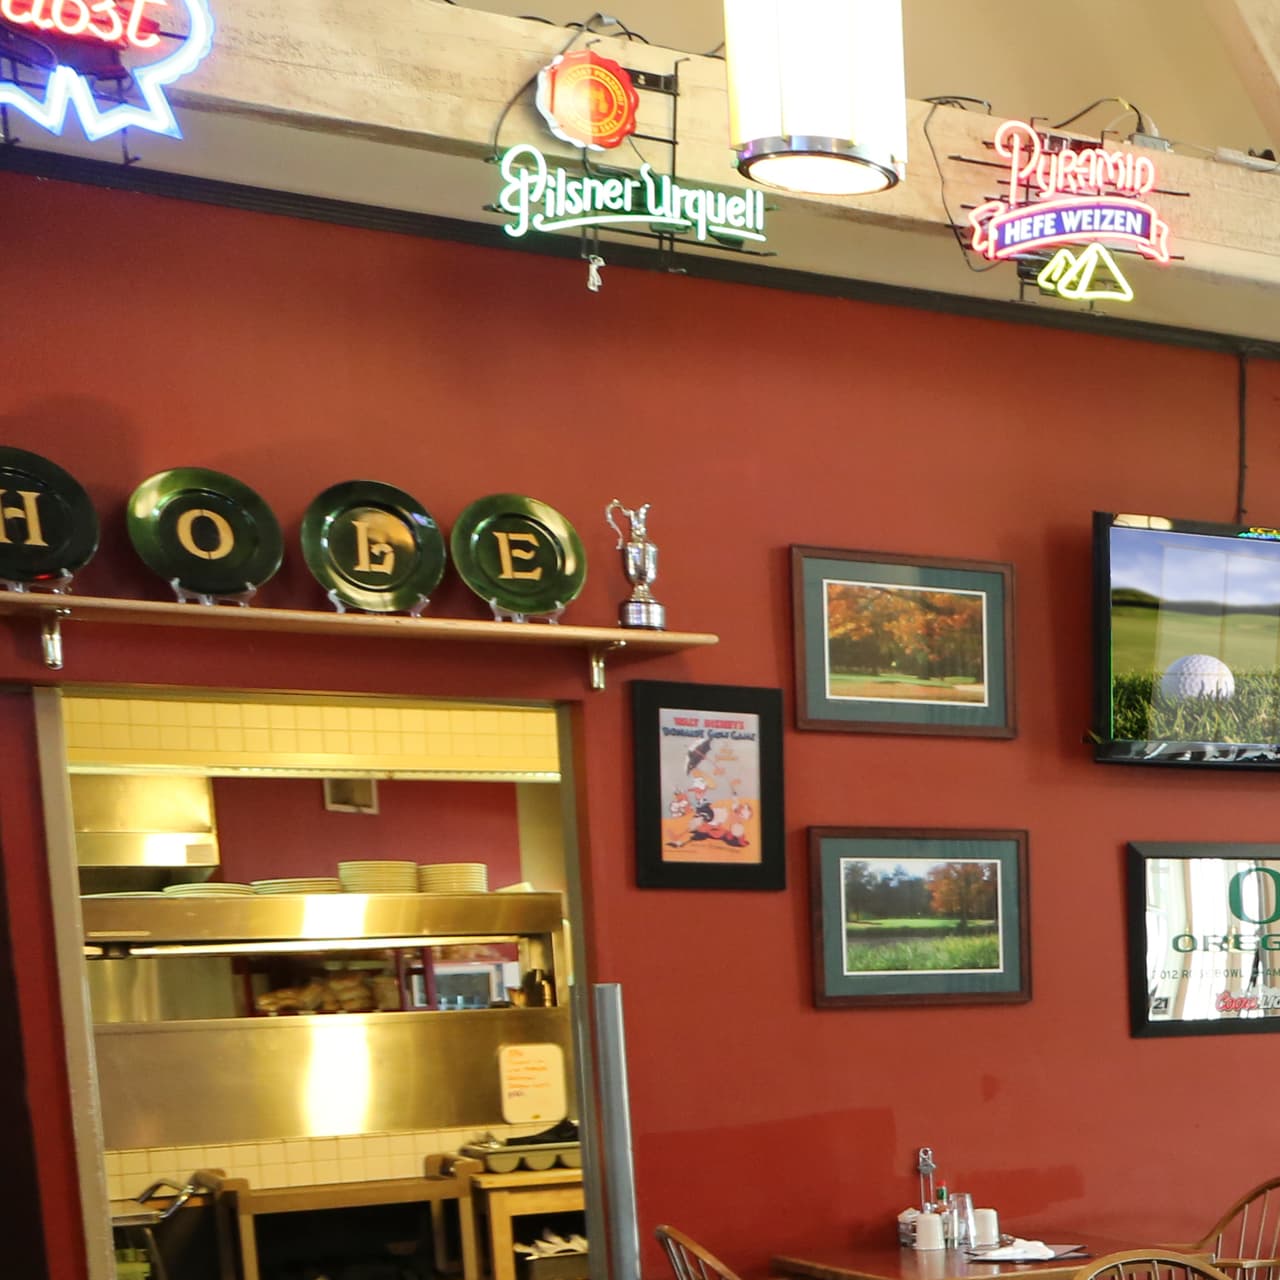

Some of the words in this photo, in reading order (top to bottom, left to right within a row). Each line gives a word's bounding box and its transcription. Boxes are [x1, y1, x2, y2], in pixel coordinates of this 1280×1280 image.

[499, 143, 641, 238] Pilsner
[639, 162, 765, 241] Urquell
[1004, 213, 1058, 245] HEFE
[1061, 209, 1143, 235] WEIZEN
[1152, 997, 1168, 1009] 21
